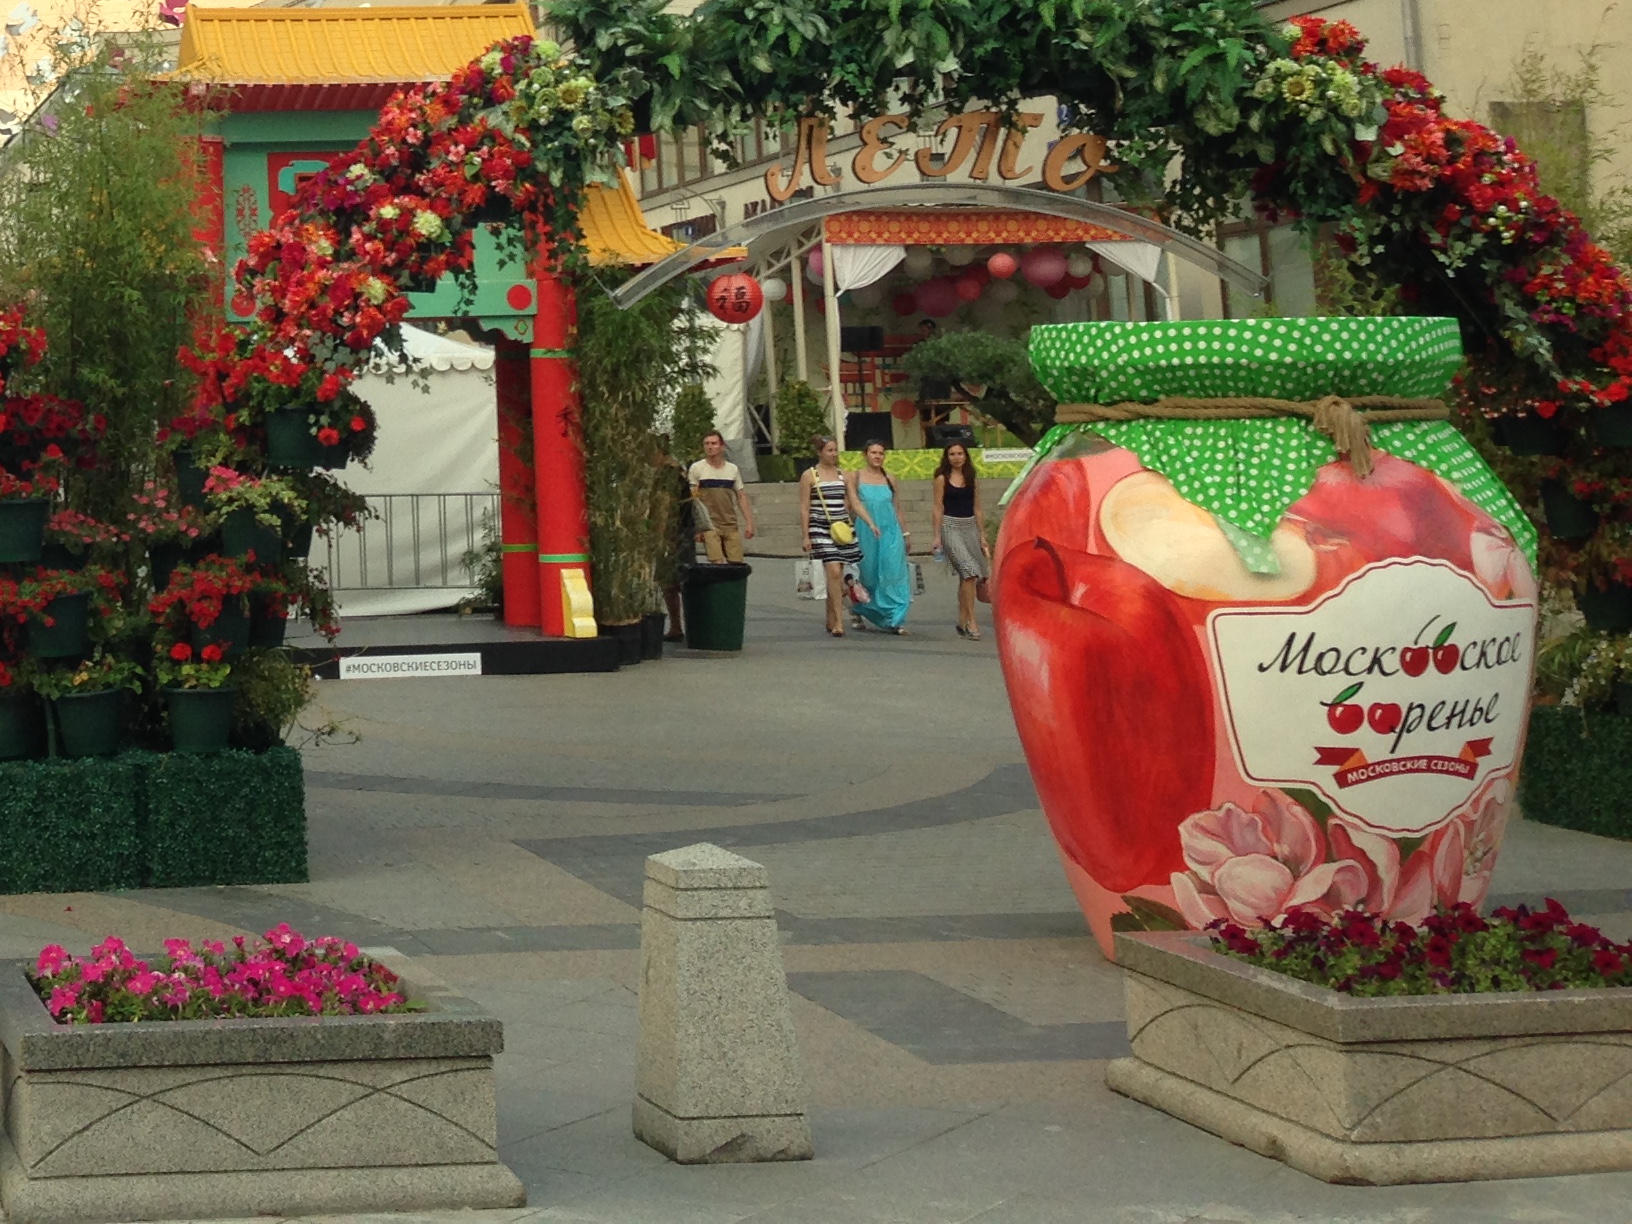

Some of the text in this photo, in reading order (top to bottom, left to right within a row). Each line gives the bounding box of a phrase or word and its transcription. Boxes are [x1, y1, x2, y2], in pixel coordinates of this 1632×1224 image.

[766, 112, 1119, 202] ЛЕТО
[345, 660, 477, 674] #МОСКОВСКИЕСЕЗОНЫ
[1347, 759, 1470, 784] МОСКОВСКИЕ СЕЗОНЫ
